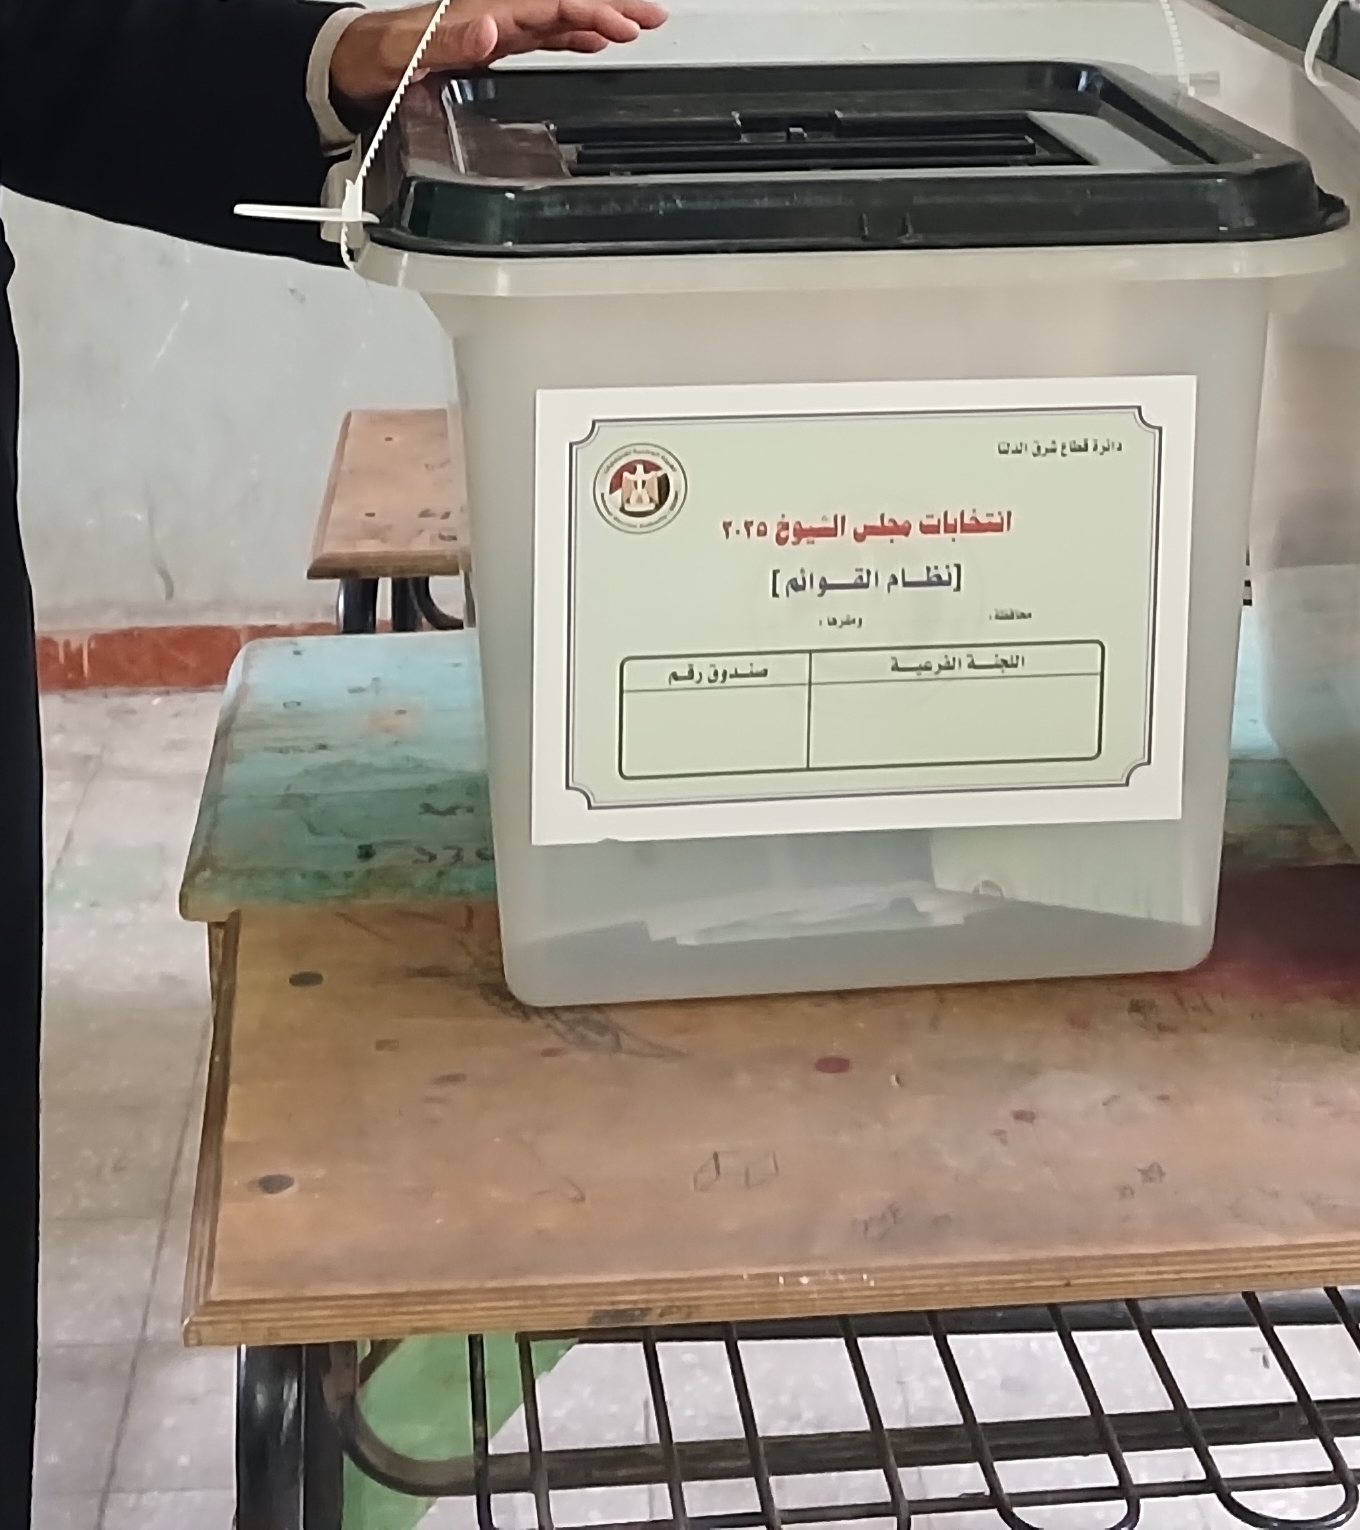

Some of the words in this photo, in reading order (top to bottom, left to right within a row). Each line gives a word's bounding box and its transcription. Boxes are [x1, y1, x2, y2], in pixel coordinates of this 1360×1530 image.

[721, 519, 769, 540] ٢٠٢٥
[774, 513, 847, 547] الشيوخ
[852, 512, 913, 544] مجلس
[918, 508, 1013, 543] انتخابات
[668, 663, 703, 686] رقم
[706, 662, 769, 684] صندوق
[890, 656, 962, 677] الفرعية
[965, 653, 1025, 674] اللجنة
